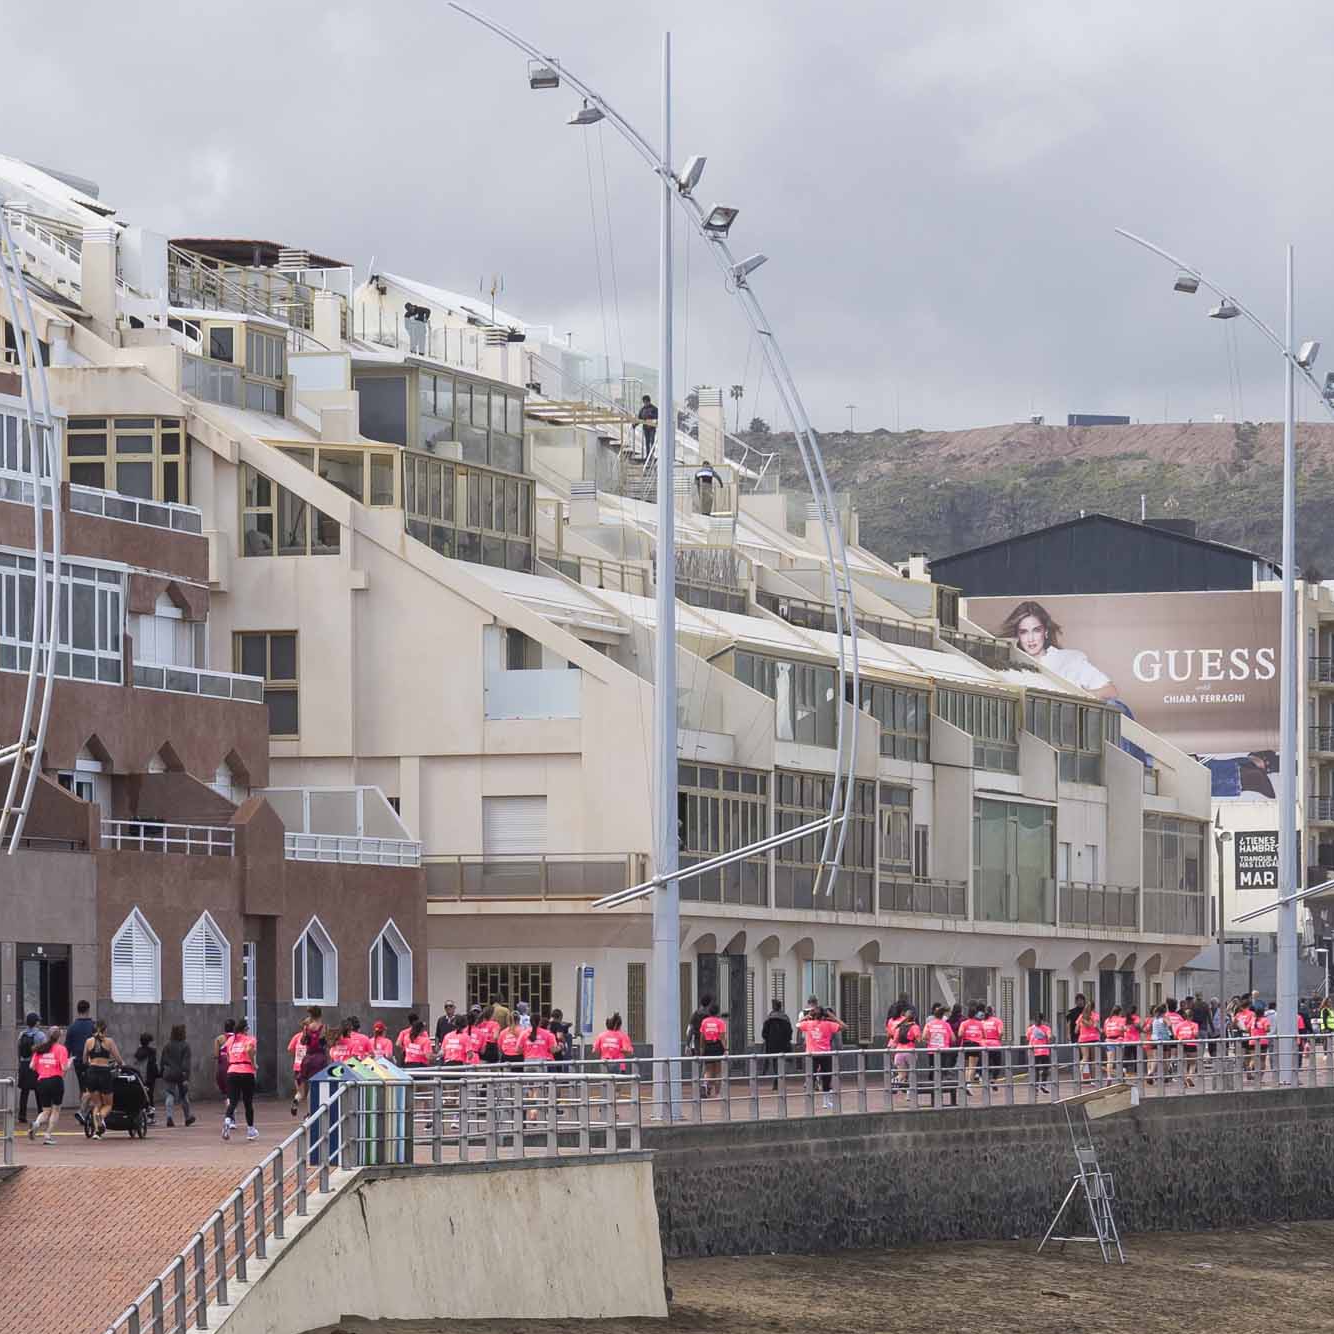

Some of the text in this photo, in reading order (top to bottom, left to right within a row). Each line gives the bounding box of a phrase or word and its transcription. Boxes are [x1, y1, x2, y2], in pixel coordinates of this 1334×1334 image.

[1132, 647, 1276, 682] GUESS
[1163, 693, 1245, 704] CHIARA FERRAGNI
[1240, 871, 1275, 886] MAR
